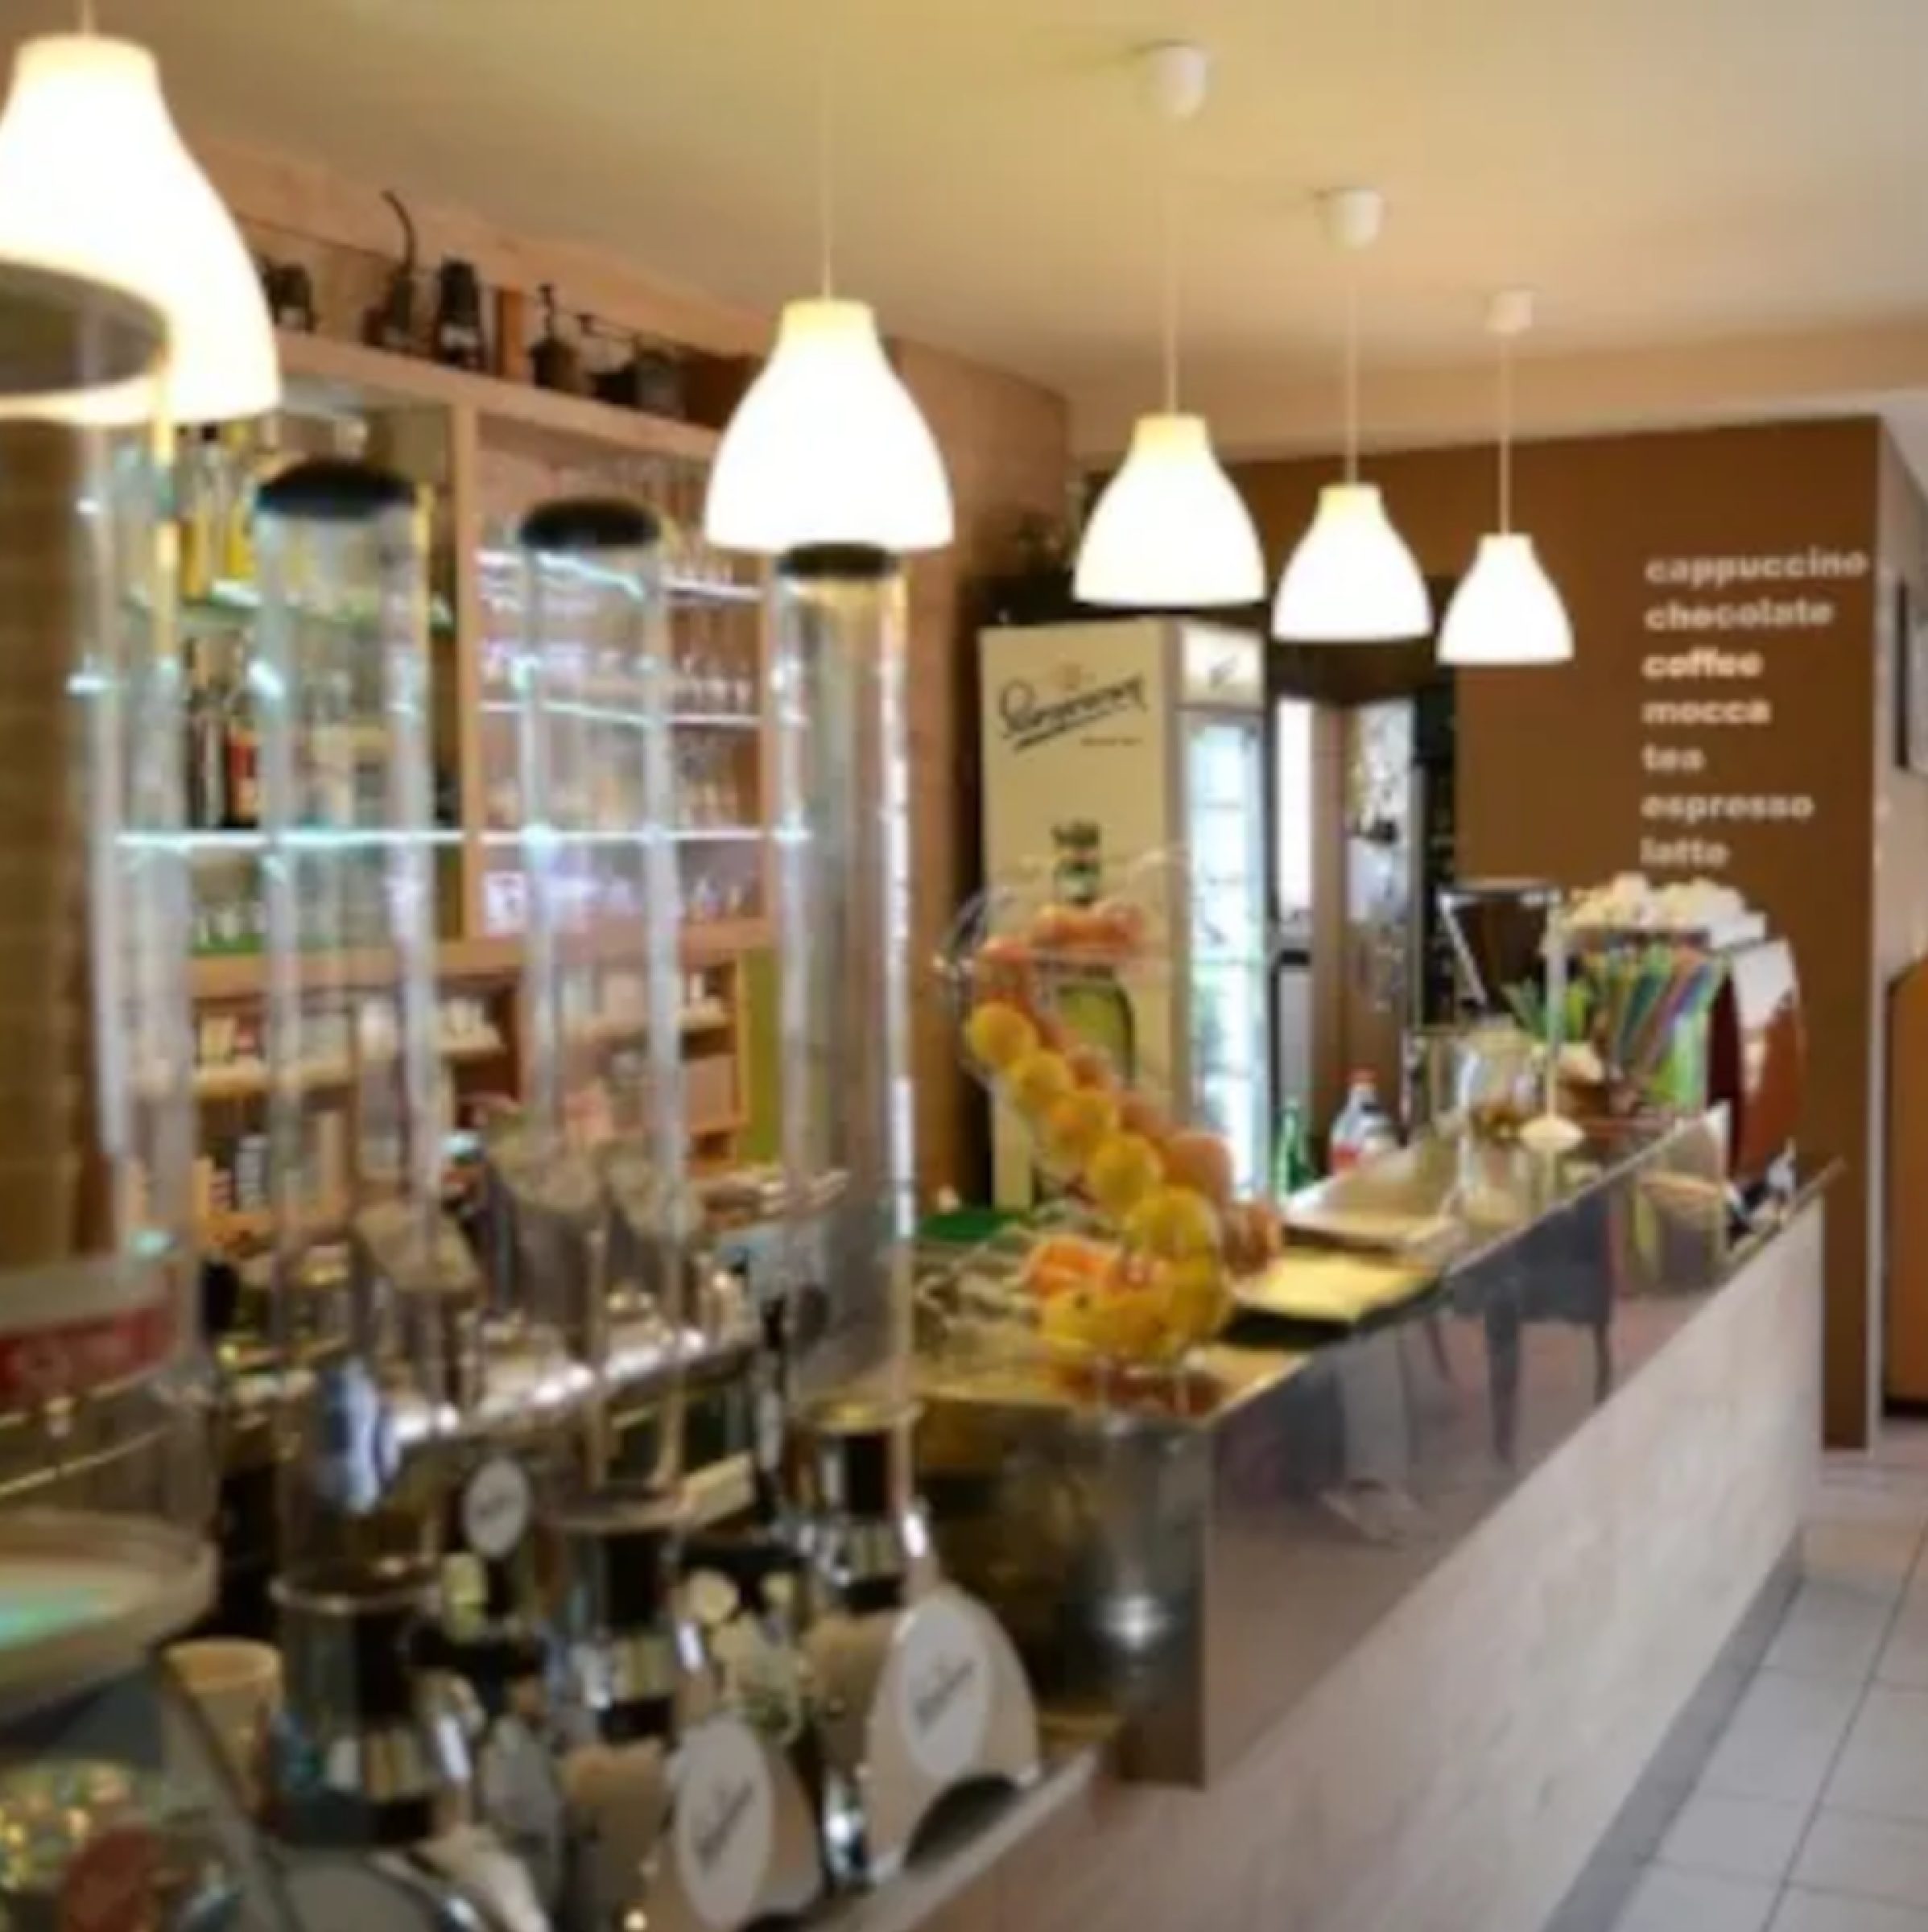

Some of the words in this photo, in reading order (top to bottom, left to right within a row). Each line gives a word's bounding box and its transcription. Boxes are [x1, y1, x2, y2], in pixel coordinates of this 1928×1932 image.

[1645, 547, 1868, 586] cappuccino
[1645, 600, 1835, 630] chocolate
[1642, 647, 1763, 679] coffee
[1642, 700, 1771, 724] mocca
[1642, 745, 1705, 771] tea
[1641, 795, 1814, 824] espresso
[1640, 837, 1731, 867] latte
